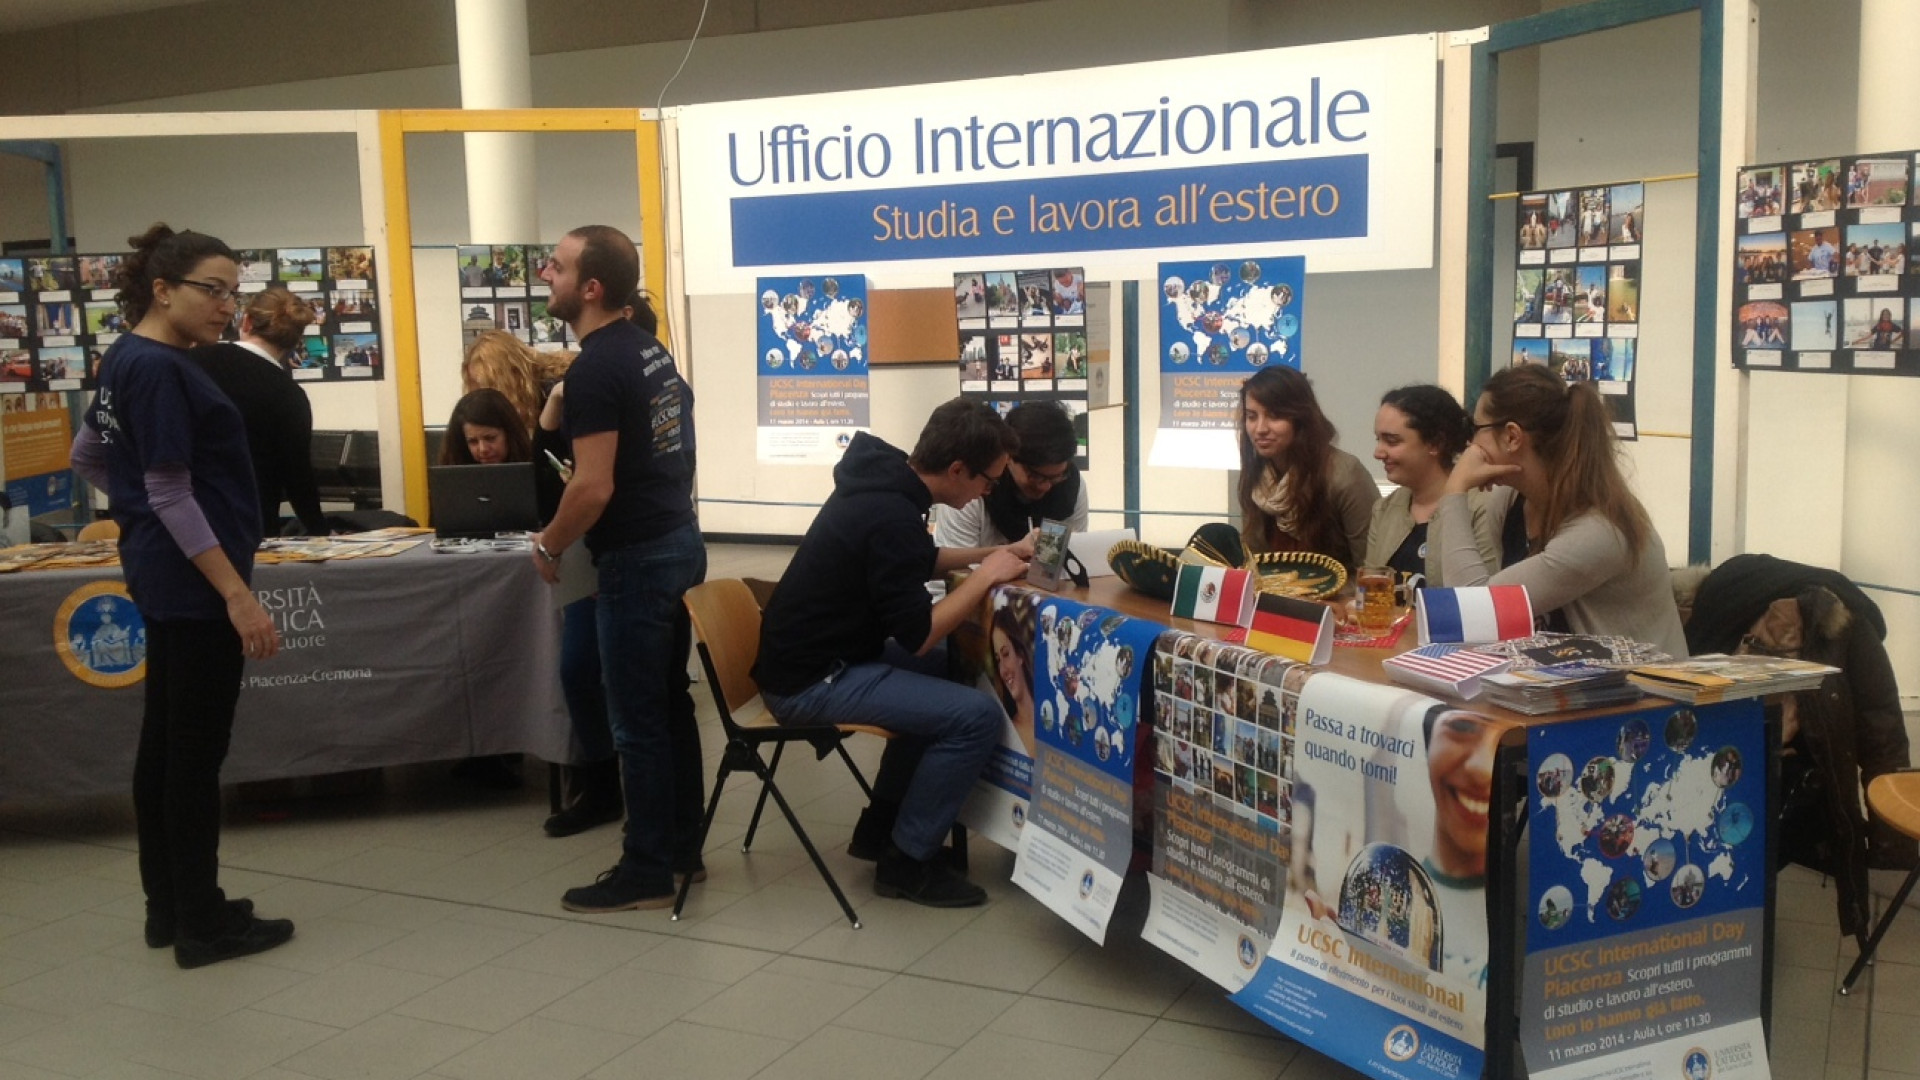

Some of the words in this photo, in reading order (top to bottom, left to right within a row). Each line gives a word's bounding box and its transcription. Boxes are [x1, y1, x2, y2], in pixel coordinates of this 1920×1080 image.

[728, 122, 892, 187] Ufficio
[914, 77, 1370, 175] Internazionale
[872, 200, 980, 242] Studia
[992, 204, 1016, 235] e
[1029, 194, 1142, 234] lavora
[1155, 182, 1340, 227] all'estero
[252, 580, 322, 610] RSITÀ
[268, 608, 325, 632] LICA
[1306, 708, 1343, 737] Passa
[1347, 724, 1356, 740] a
[1360, 725, 1415, 759] trovarci
[1304, 741, 1356, 771] quando
[1360, 757, 1398, 785] torni!
[1297, 923, 1345, 960] UCSC
[1348, 945, 1467, 1013] International
[1544, 949, 1594, 976] UCSC
[1597, 924, 1708, 966] International
[1712, 922, 1745, 942] Day
[1544, 970, 1623, 999] Piacenza
[1627, 962, 1661, 983] Scopri
[1663, 958, 1684, 974] tutti
[1692, 944, 1752, 971] programmi
[1295, 952, 1319, 968] punto
[1319, 958, 1329, 972] di
[1329, 965, 1371, 989] riferimento
[1371, 984, 1385, 997] per
[1407, 998, 1428, 1016] studi
[1544, 1005, 1555, 1020] di
[1558, 999, 1593, 1017] studio
[1596, 997, 1603, 1008] e
[1606, 989, 1641, 1007] lavoro
[1545, 1022, 1576, 1041] Loro
[1580, 1018, 1594, 1032] lo
[1598, 1007, 1642, 1028] hanno
[1549, 1048, 1561, 1062] 11
[1564, 1041, 1597, 1058] marzo
[1600, 1033, 1625, 1050] 2014
[1633, 1025, 1656, 1041] Aula
[1665, 1021, 1681, 1033] ore
[1685, 1012, 1711, 1028] 11.30
